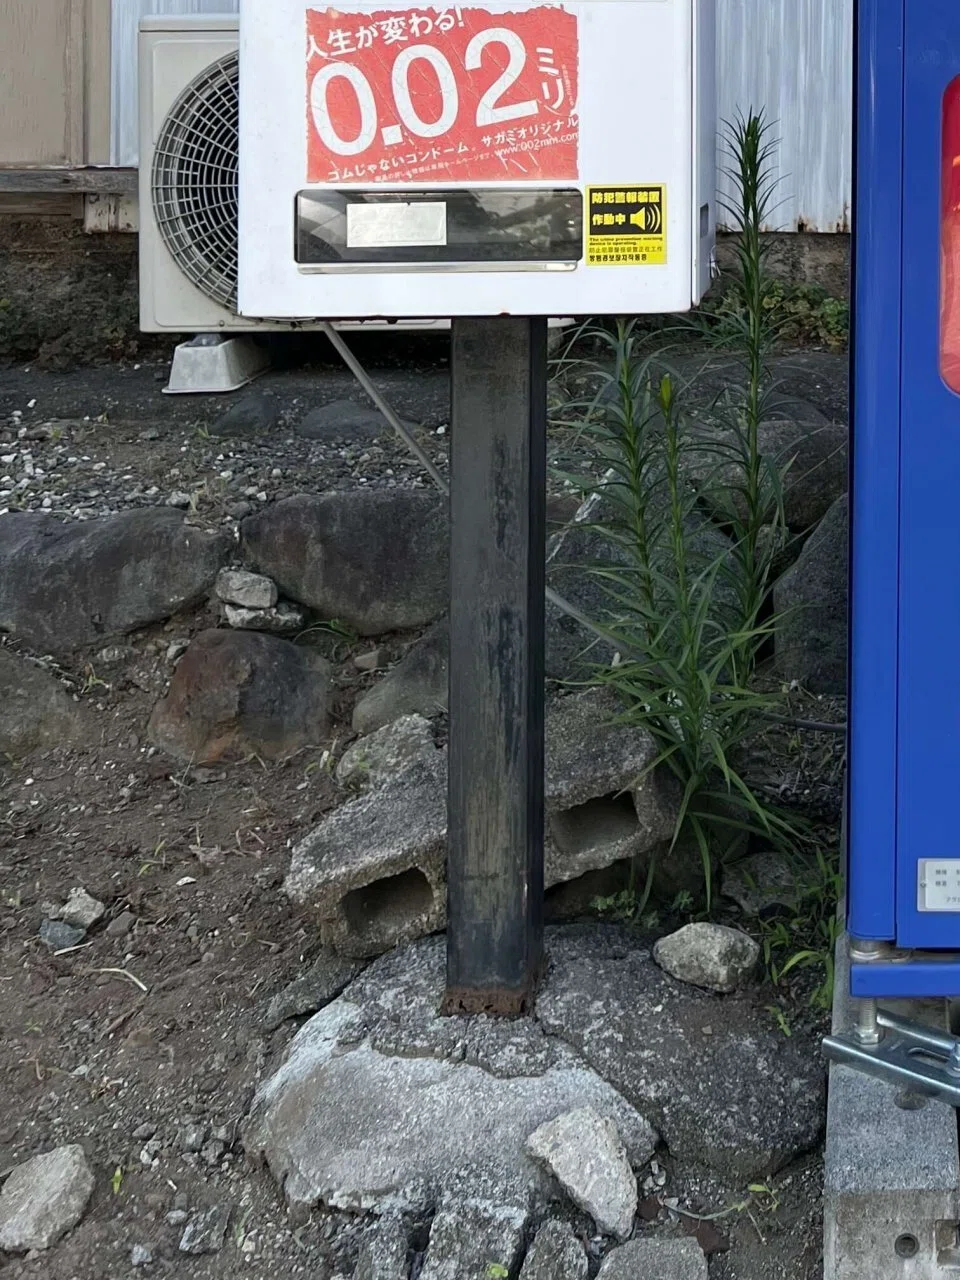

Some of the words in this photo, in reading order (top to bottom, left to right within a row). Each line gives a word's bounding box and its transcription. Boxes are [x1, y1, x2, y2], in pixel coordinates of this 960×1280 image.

[310, 27, 539, 156] 0.02
[535, 47, 566, 110] ミリ
[481, 116, 579, 146] サガミオリジナル
[592, 213, 626, 226] 作動中
